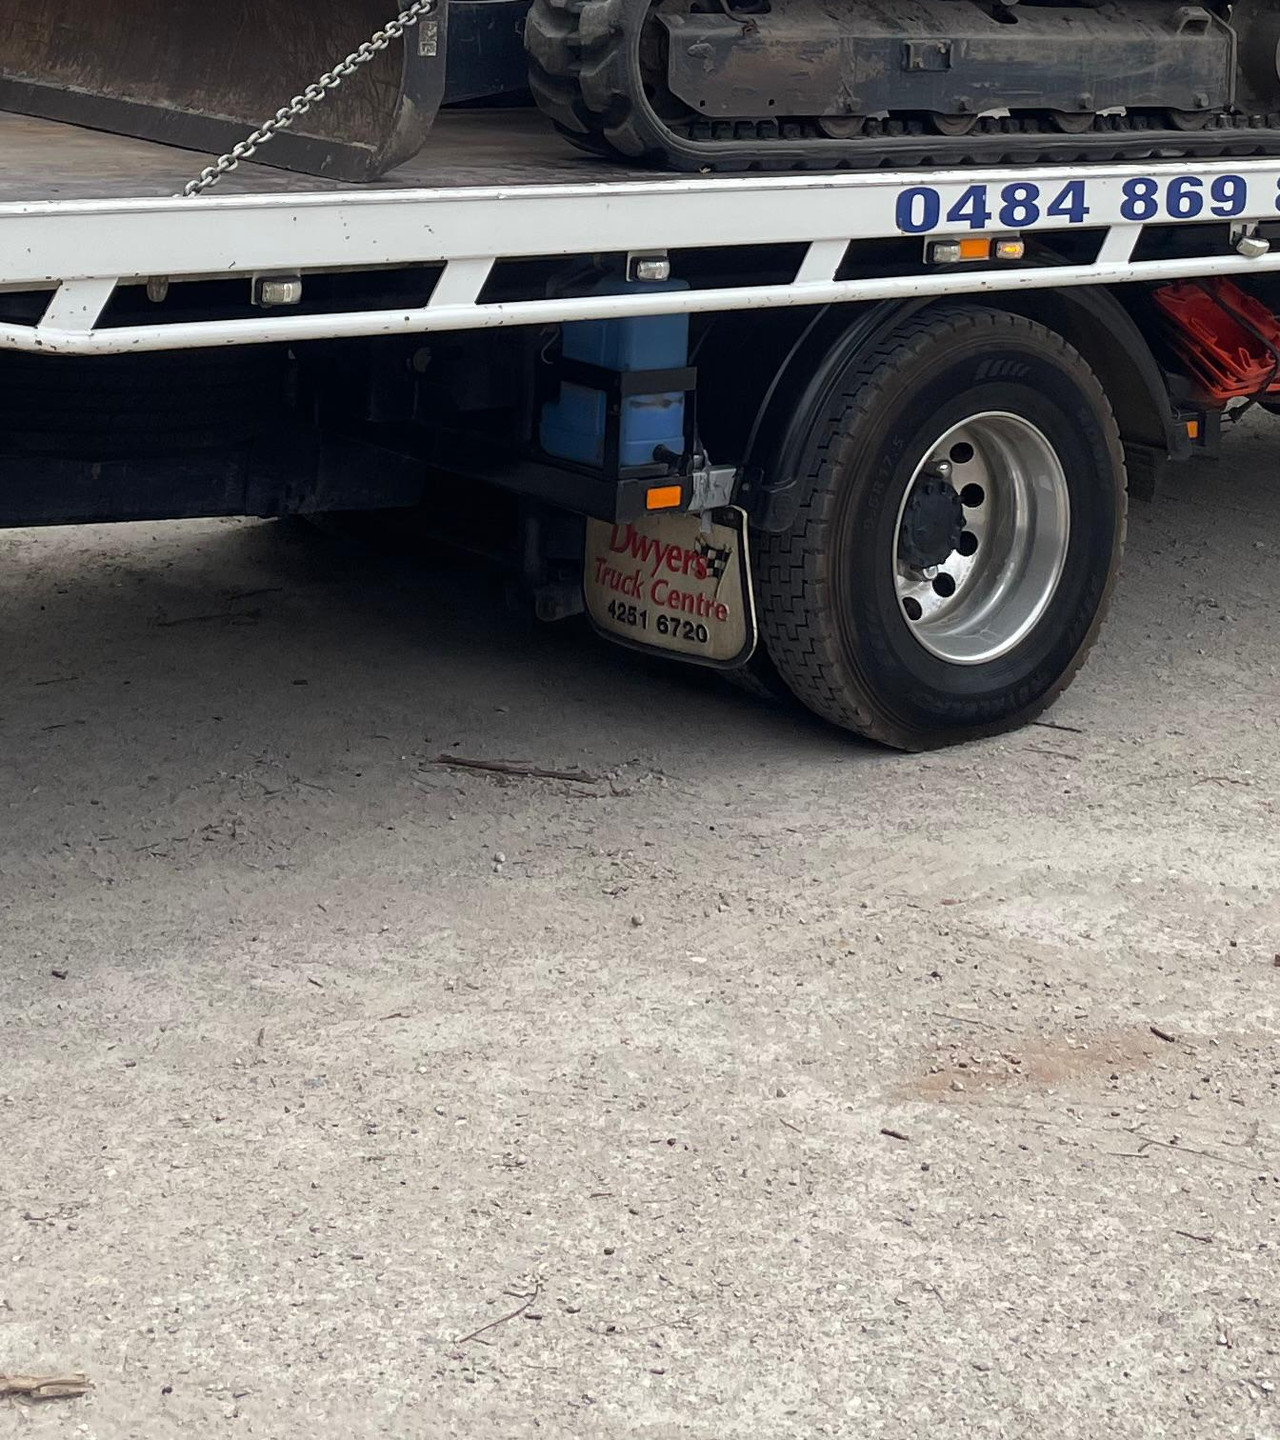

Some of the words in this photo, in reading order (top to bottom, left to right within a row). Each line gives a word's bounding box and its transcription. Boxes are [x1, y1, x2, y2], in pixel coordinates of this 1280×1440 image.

[895, 179, 1090, 233] 0484
[1120, 174, 1247, 221] 869
[609, 523, 708, 580] Dwyers
[595, 557, 645, 600] Truck
[650, 578, 730, 622] Centre
[608, 599, 648, 630] 4251
[656, 614, 708, 644] 6720
